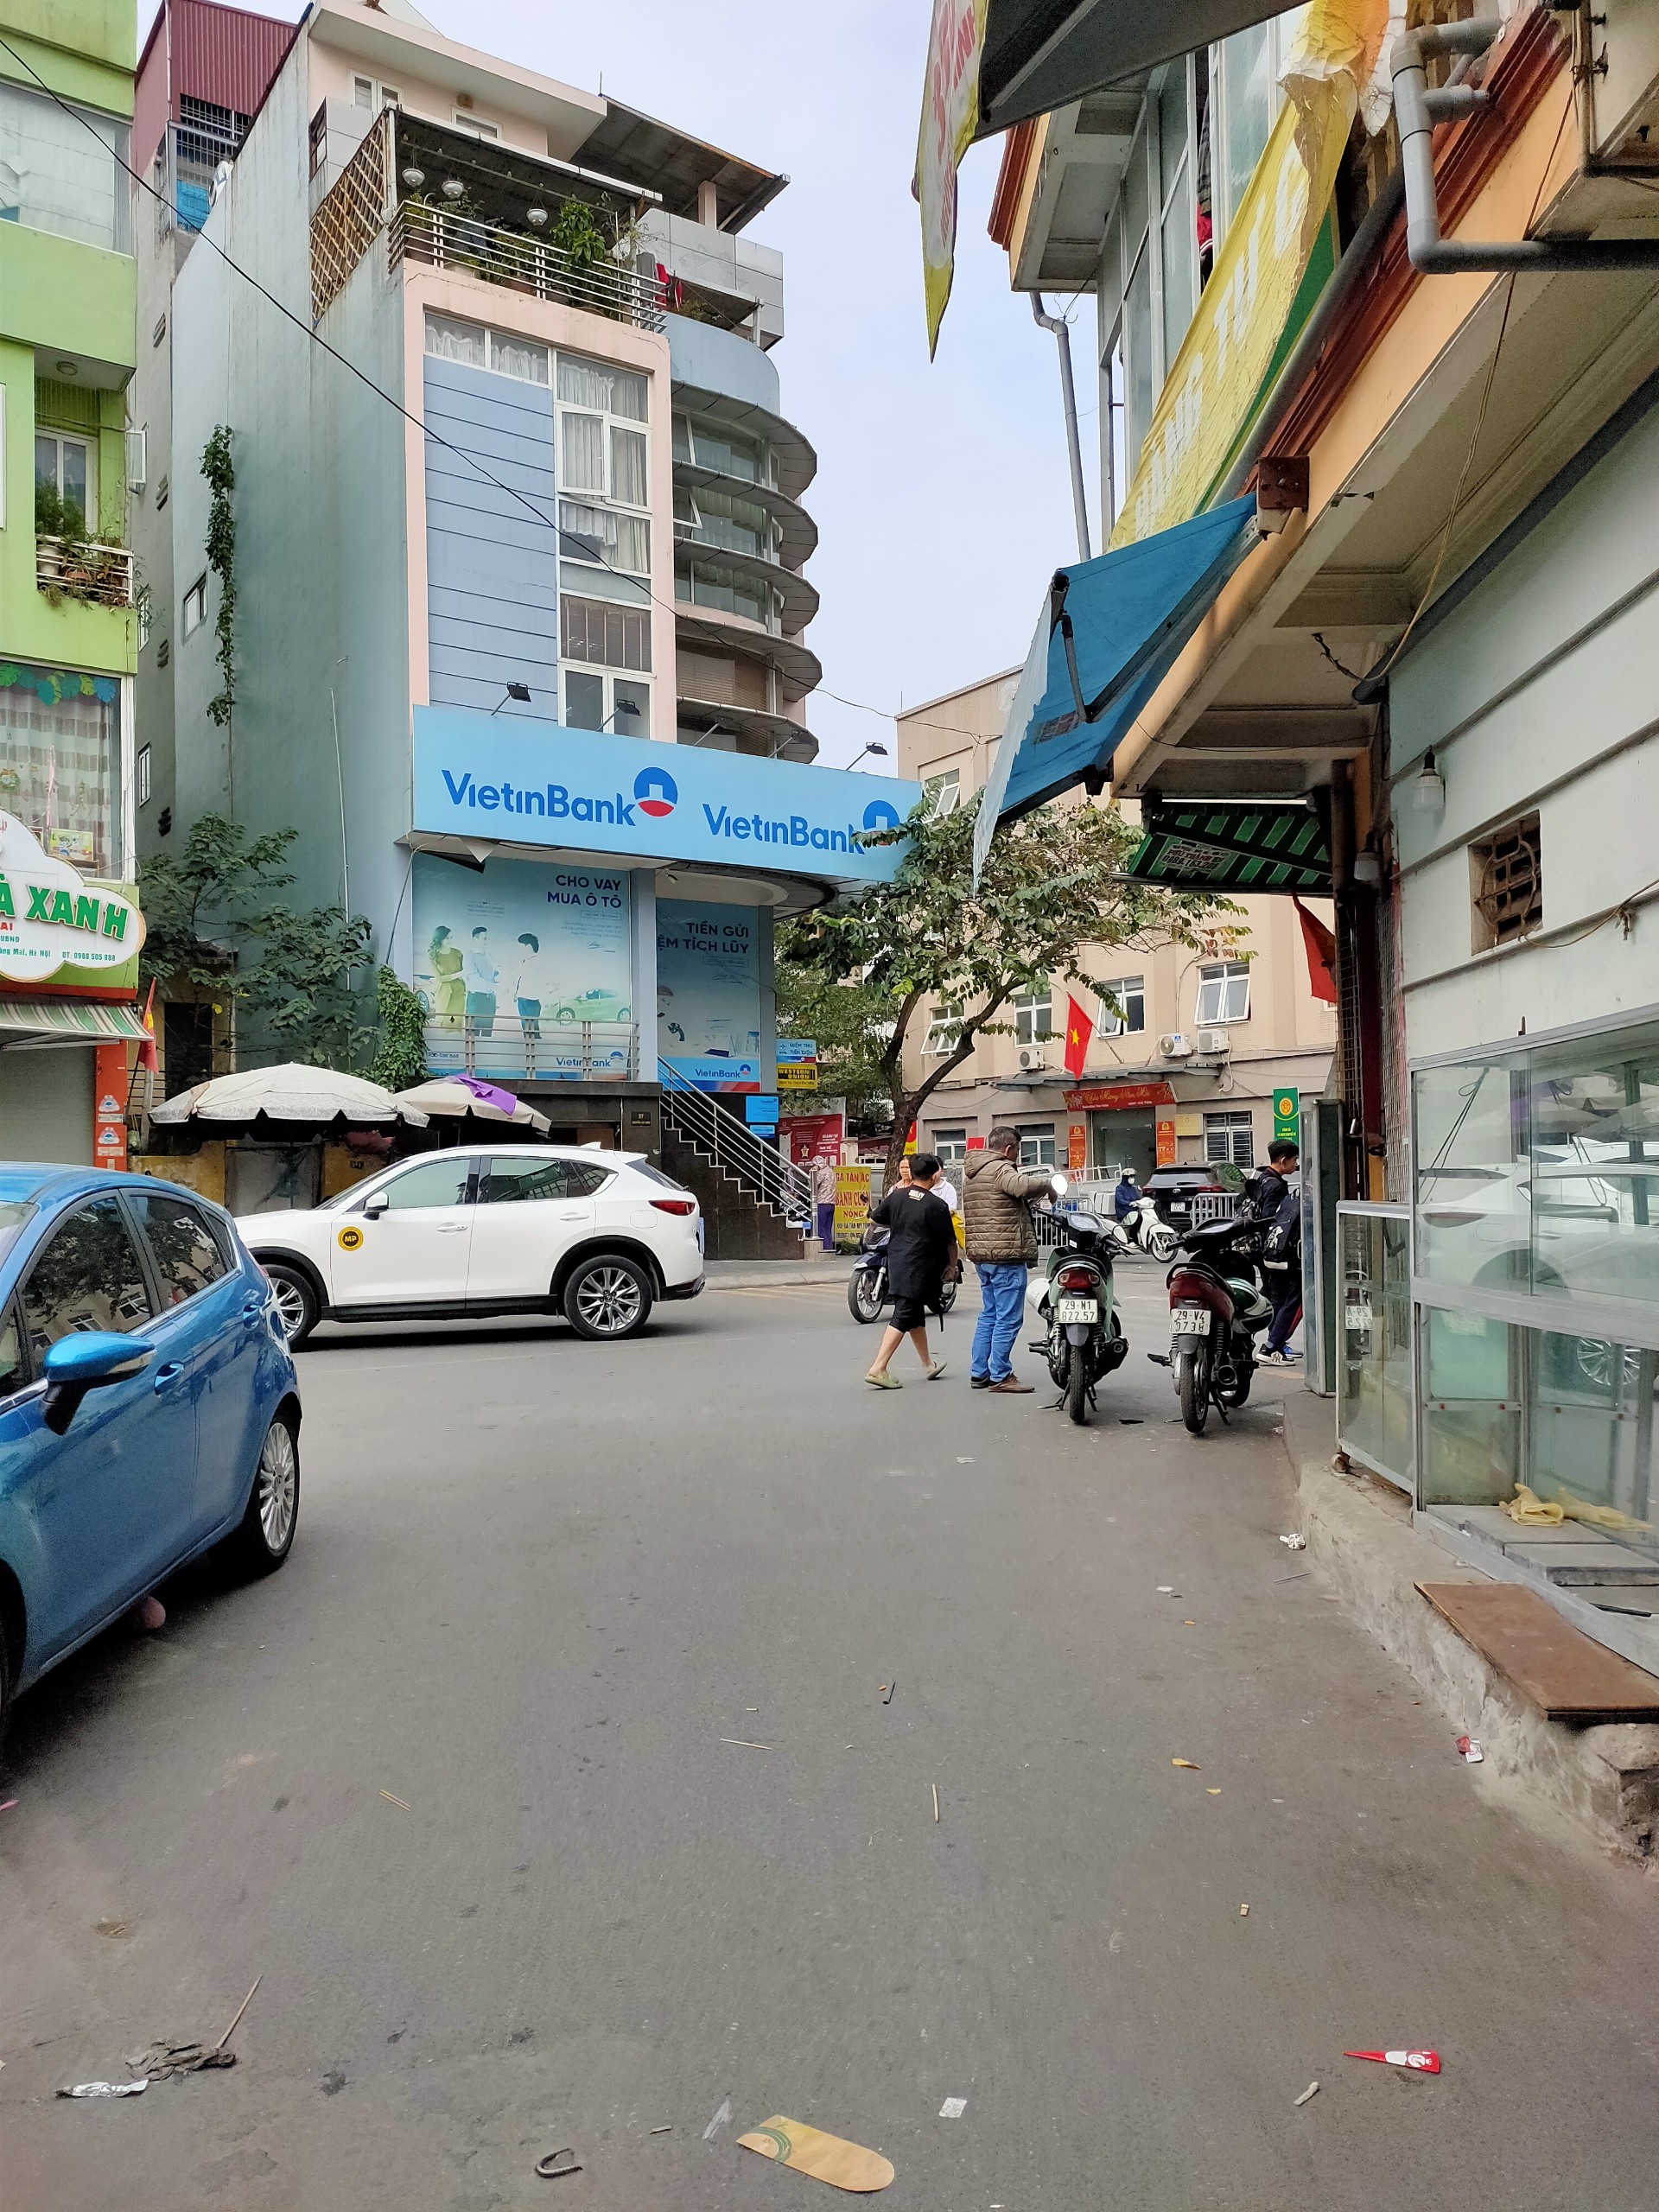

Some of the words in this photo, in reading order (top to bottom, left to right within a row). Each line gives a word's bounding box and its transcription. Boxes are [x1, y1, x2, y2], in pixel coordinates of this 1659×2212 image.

[442, 768, 637, 827] VietinBank
[702, 803, 866, 855] VietinBank
[556, 874, 589, 888] CHO
[594, 878, 622, 891] VAY
[547, 891, 582, 906] MUA
[585, 892, 598, 906] Ô
[601, 894, 622, 908] TÔ
[24, 884, 129, 941] XANH
[722, 940, 749, 954] LŨY
[556, 1057, 611, 1068] Vietinank
[695, 1068, 741, 1078] VietinBank
[1065, 1300, 1091, 1311] 29-N1
[1061, 1311, 1095, 1321] 822.57
